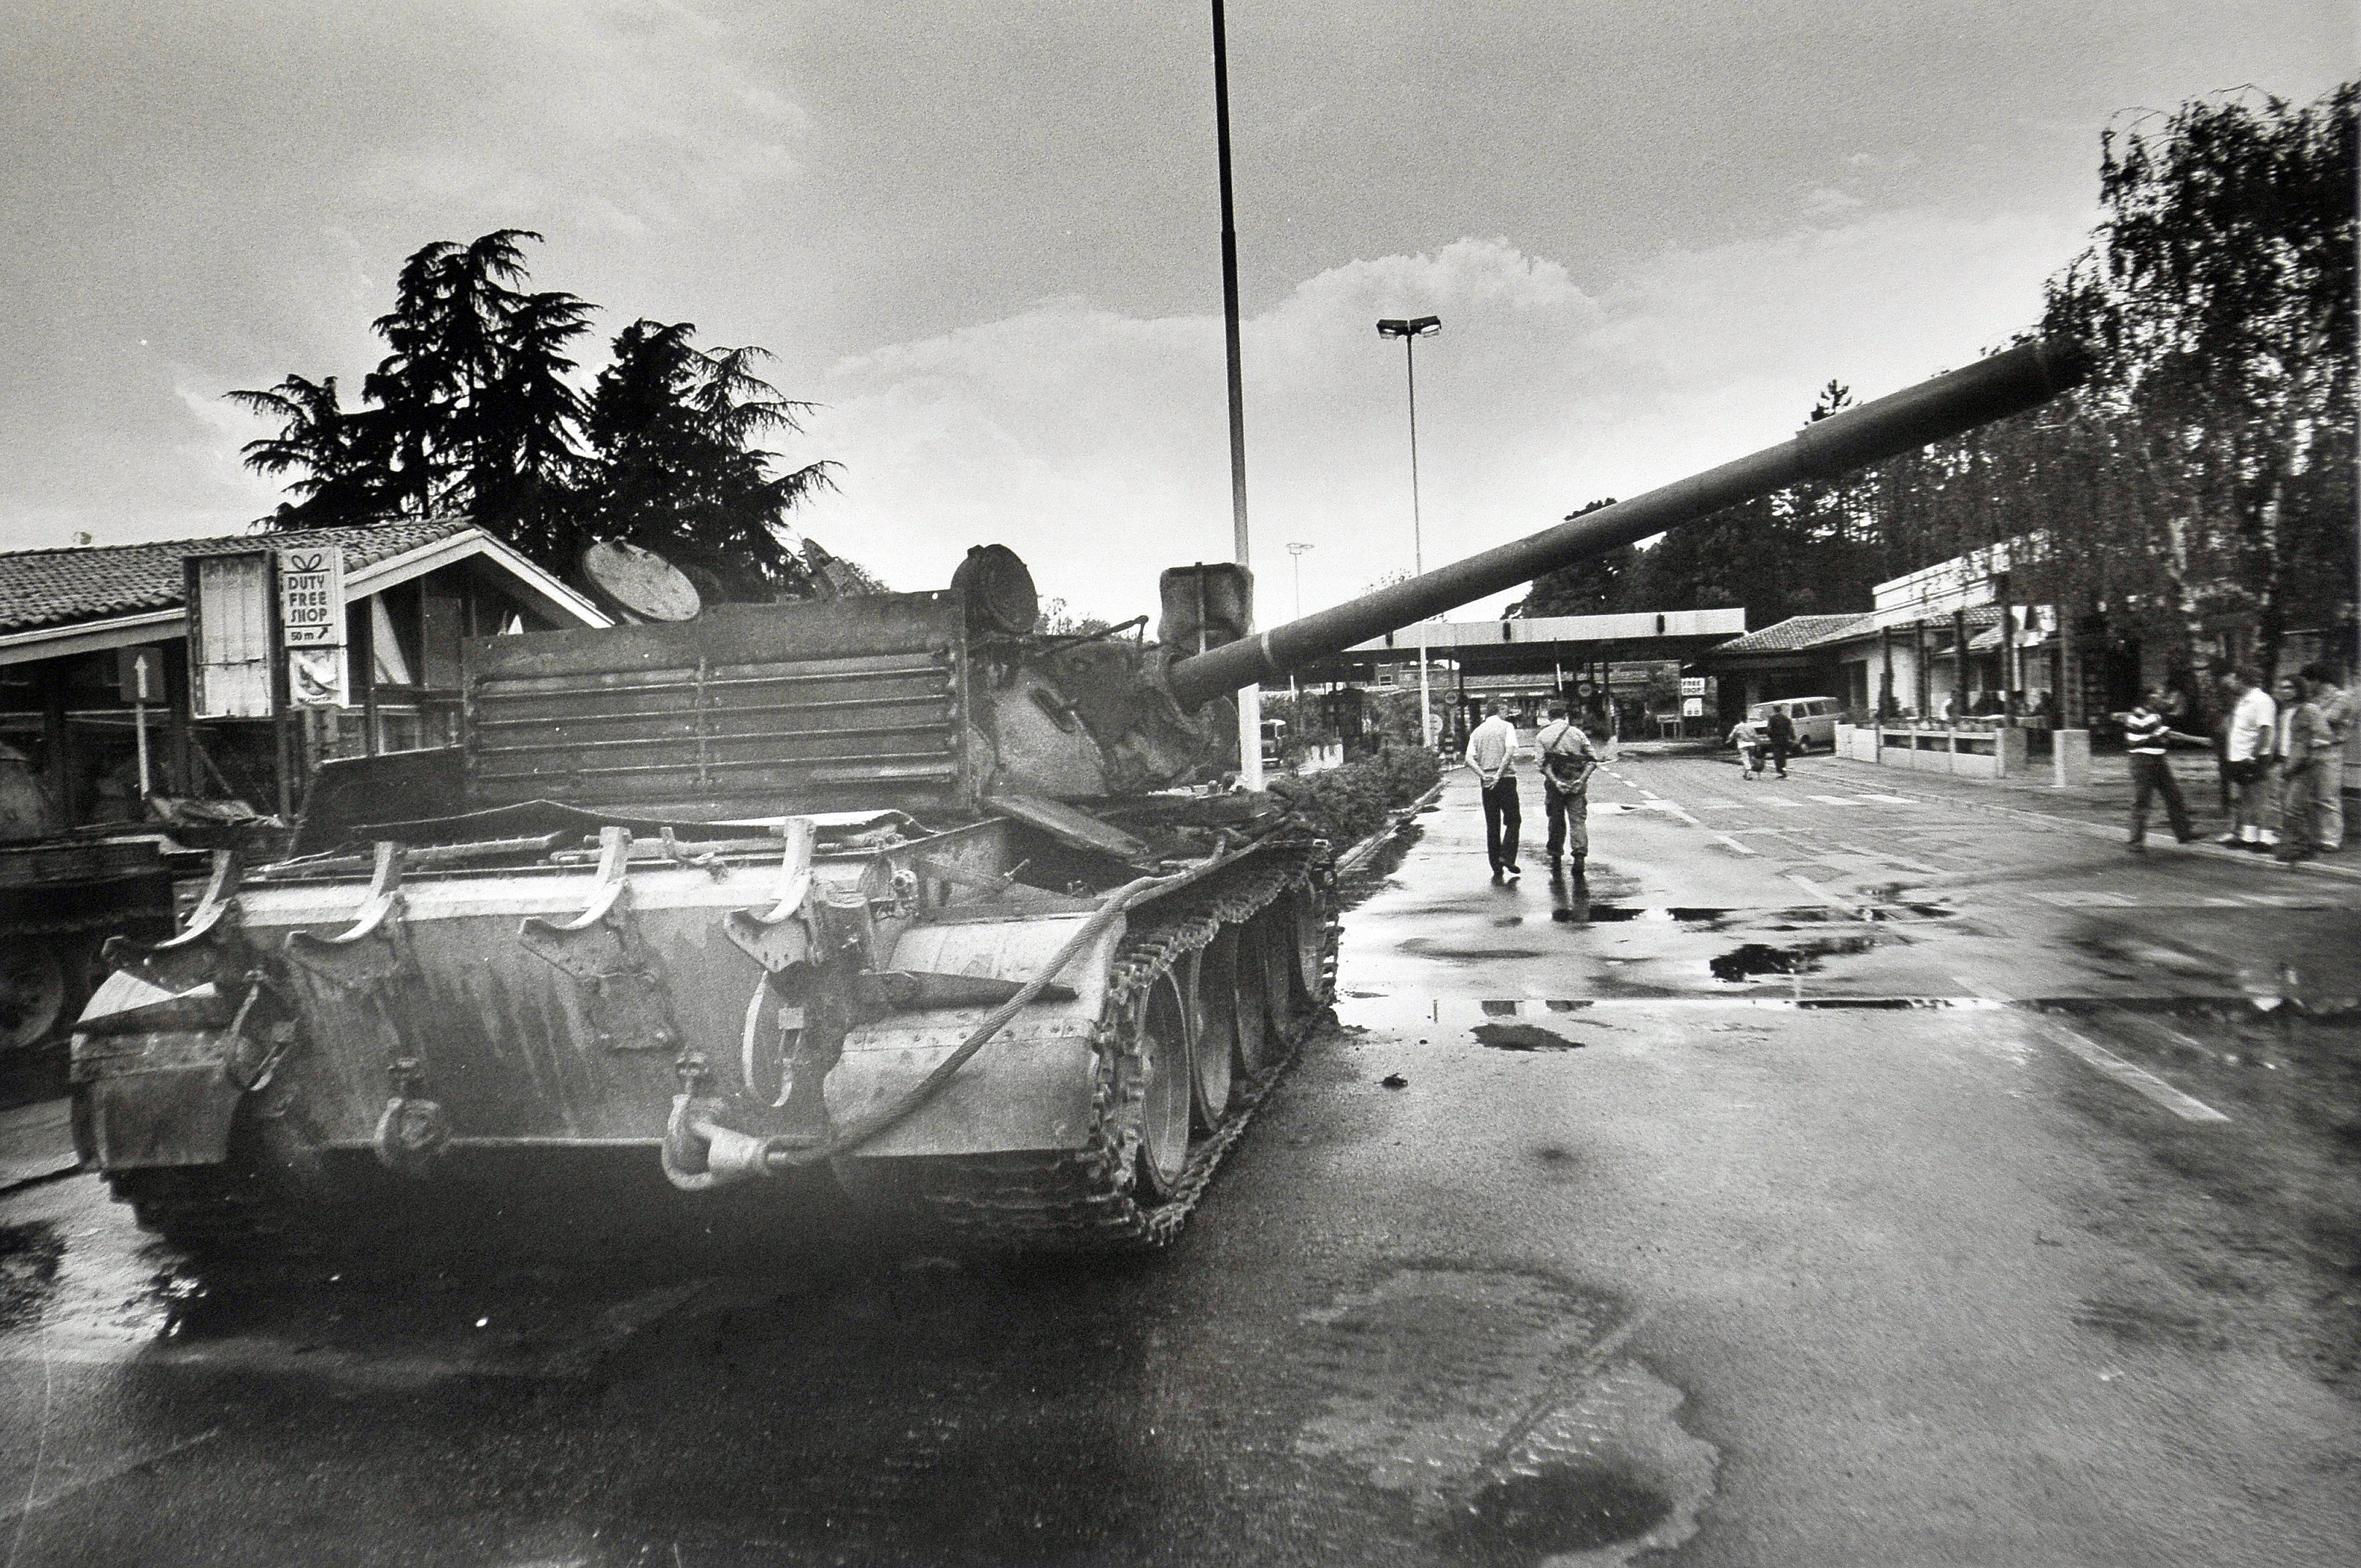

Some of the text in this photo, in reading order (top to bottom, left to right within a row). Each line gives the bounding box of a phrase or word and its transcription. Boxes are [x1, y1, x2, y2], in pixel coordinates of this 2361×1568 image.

[288, 575, 325, 590] DUTY
[289, 592, 327, 607] FREE
[290, 608, 327, 623] SHOP
[291, 631, 303, 641] 50
